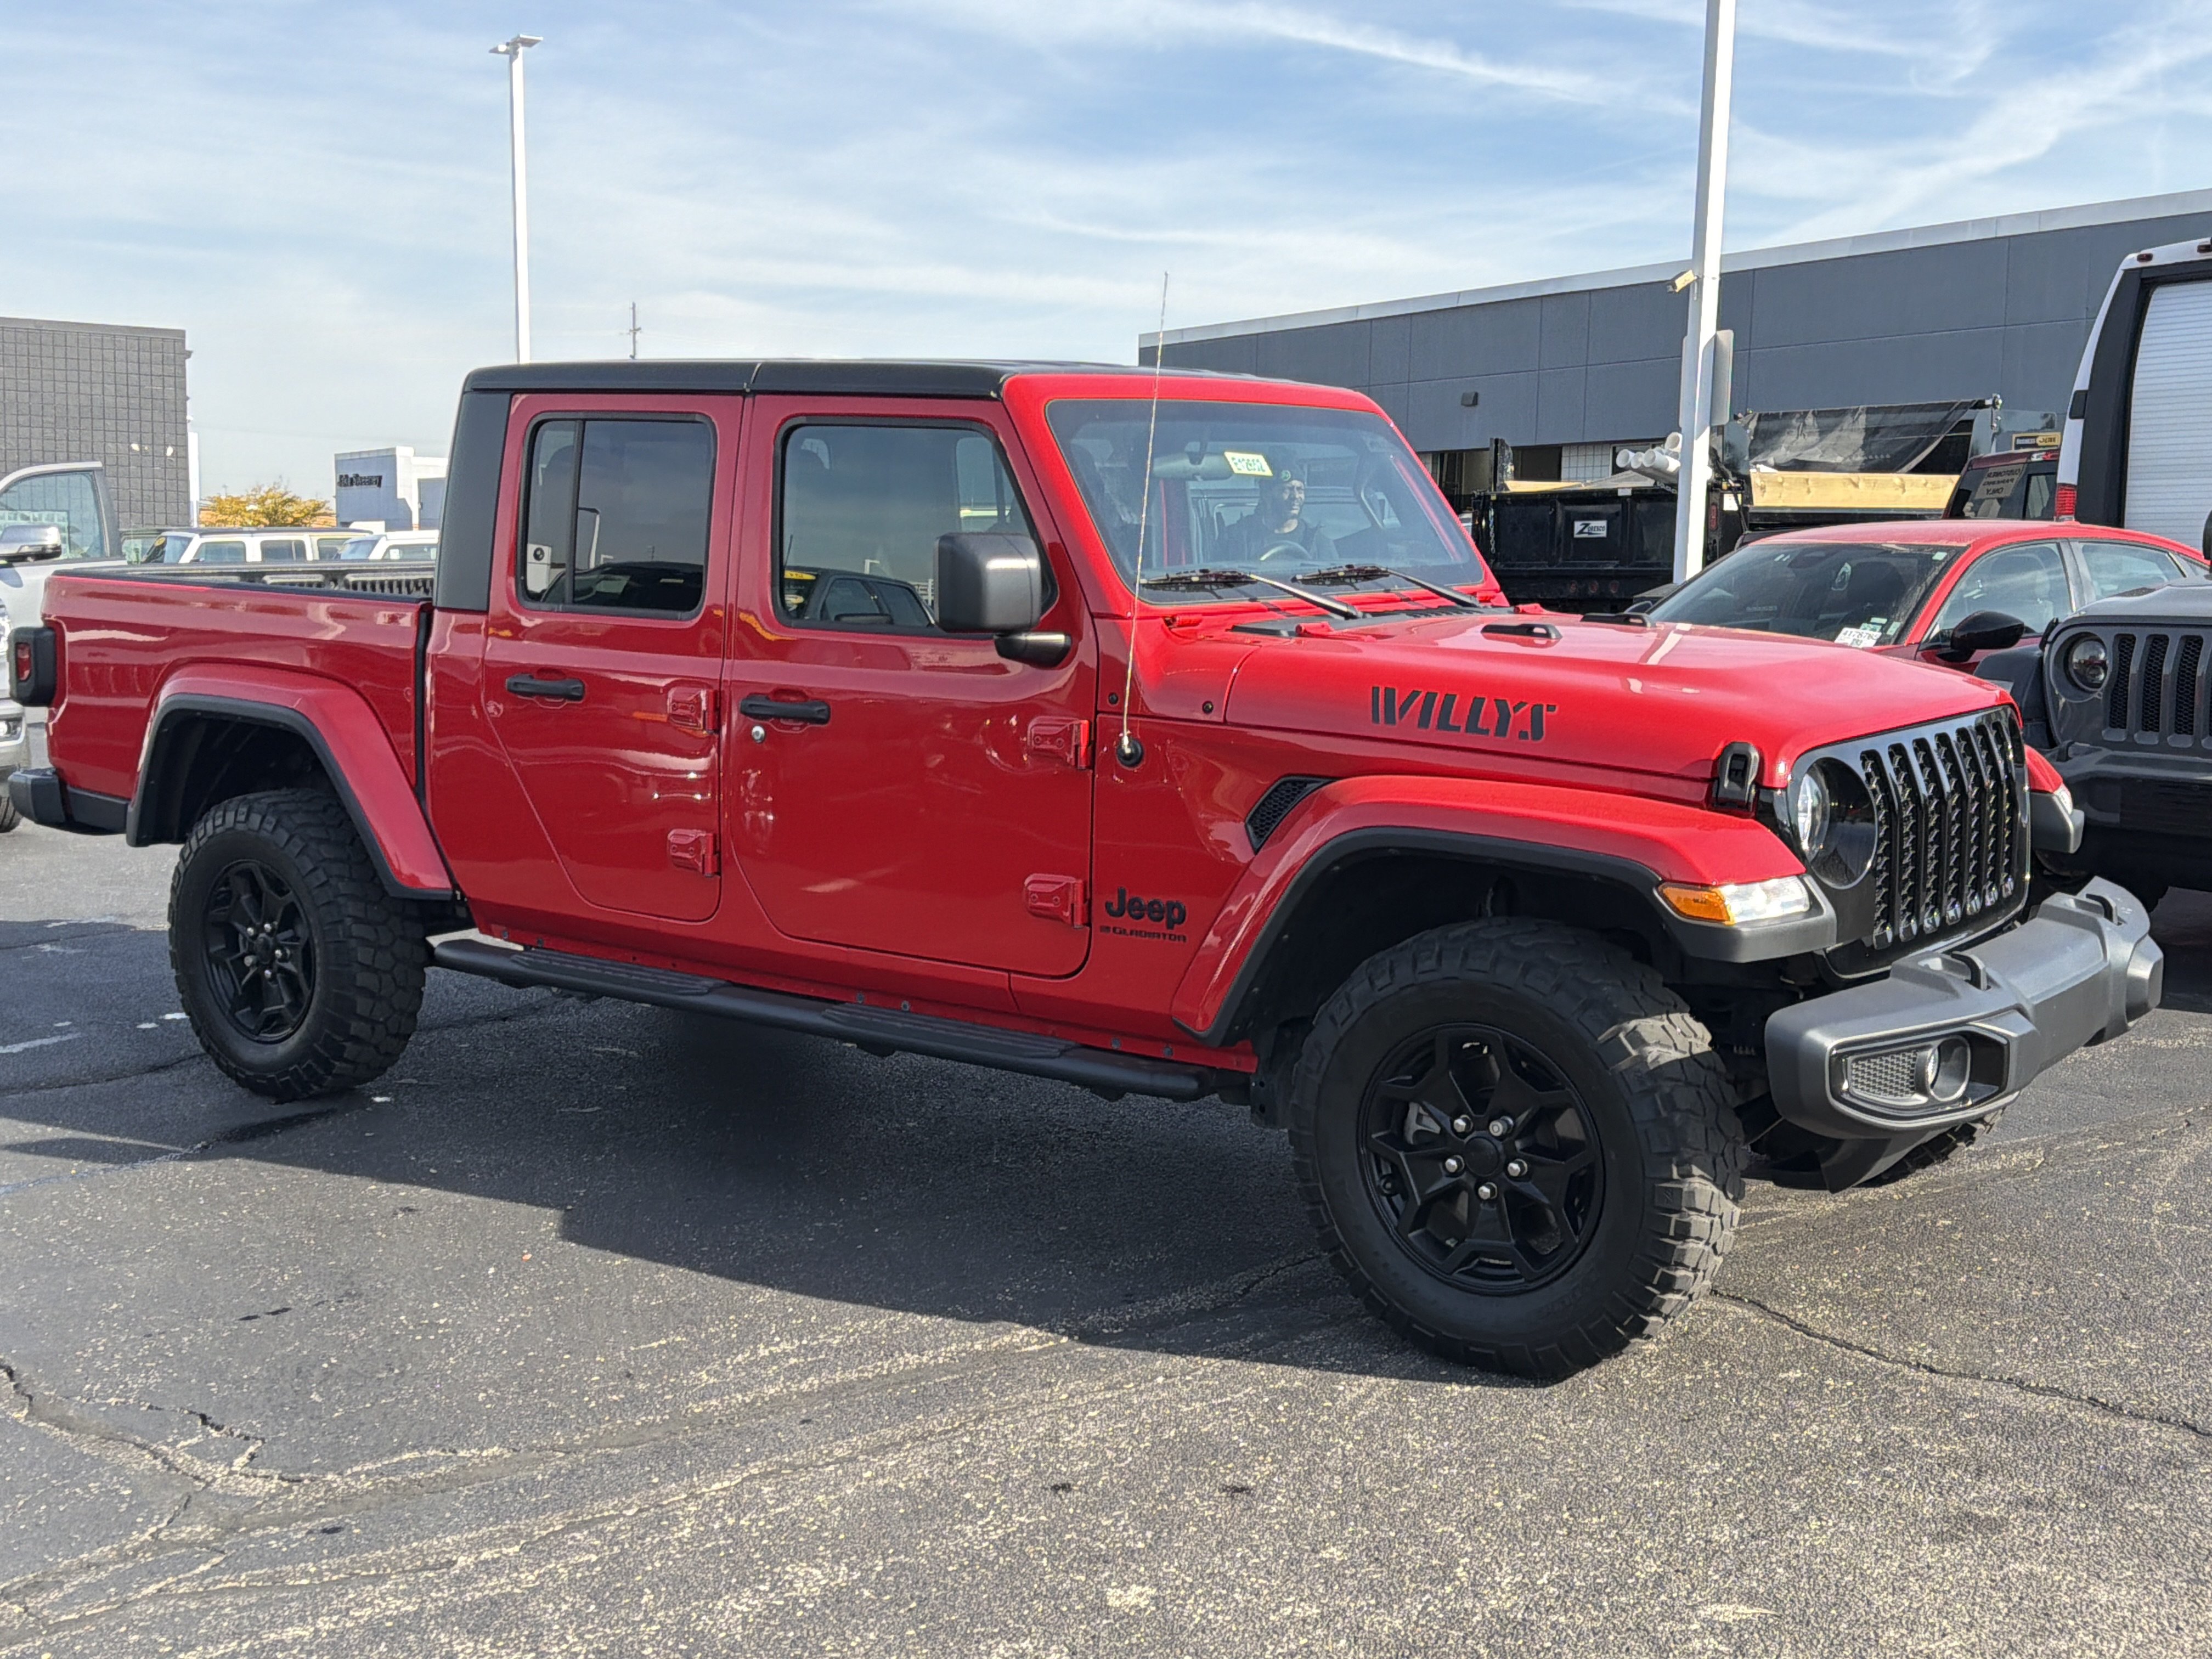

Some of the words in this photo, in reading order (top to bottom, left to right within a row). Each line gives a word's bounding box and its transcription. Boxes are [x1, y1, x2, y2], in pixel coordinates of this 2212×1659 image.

[1372, 686, 1557, 741] WILLYS
[1105, 887, 1186, 930] Jeep
[1112, 926, 1187, 943] GLADIATOR
